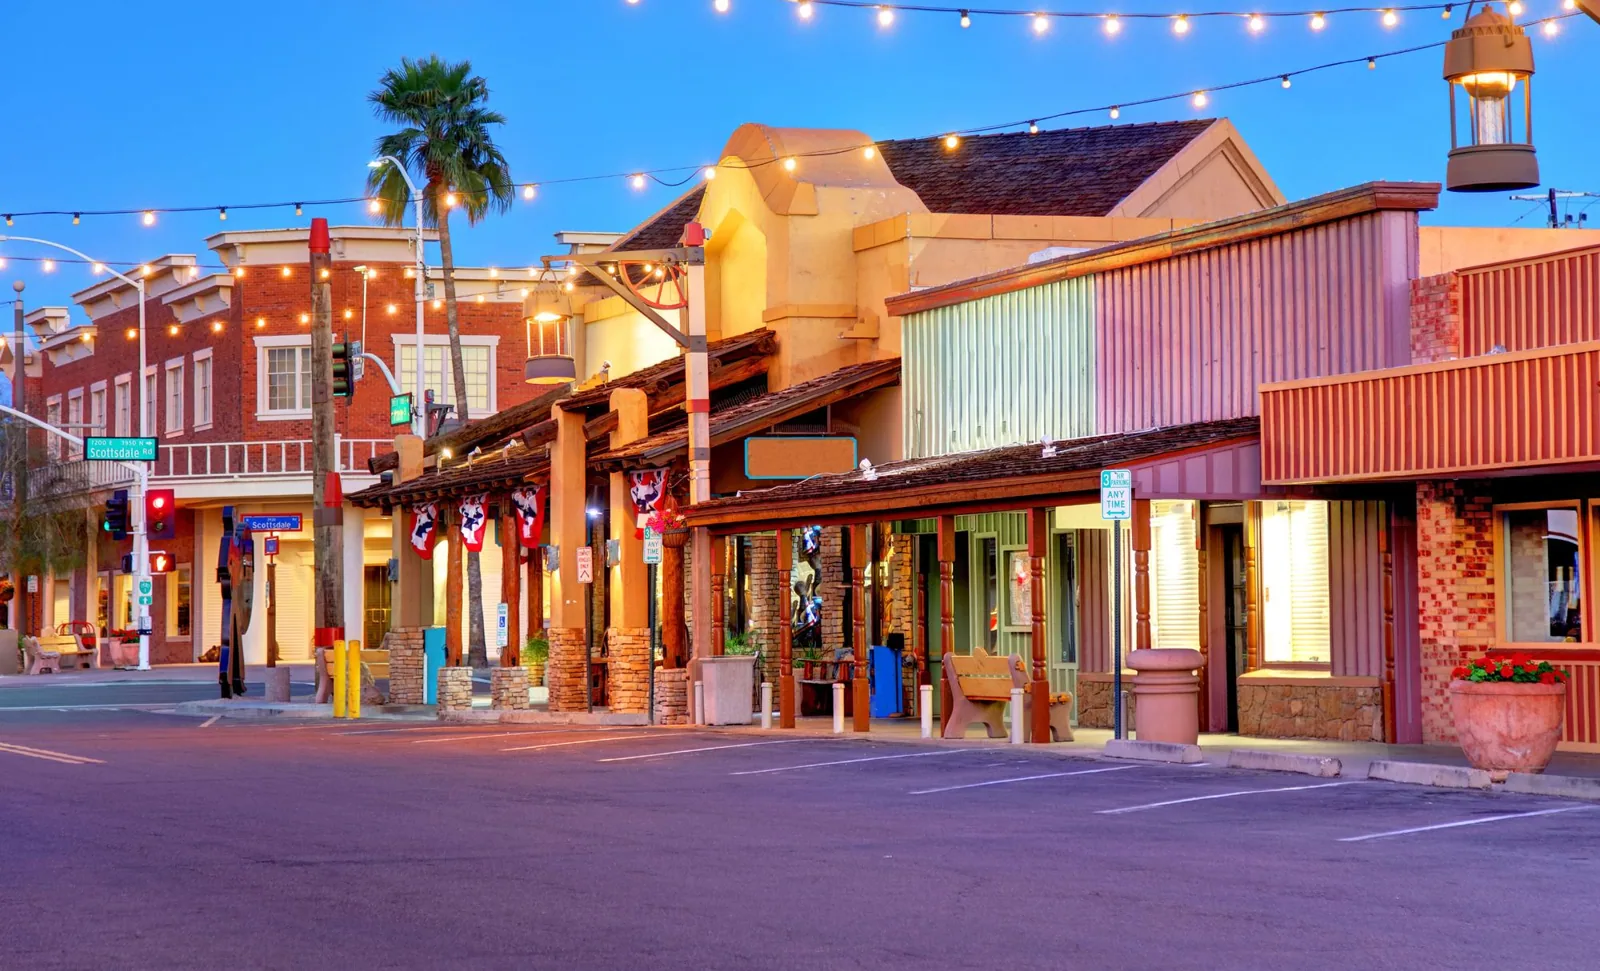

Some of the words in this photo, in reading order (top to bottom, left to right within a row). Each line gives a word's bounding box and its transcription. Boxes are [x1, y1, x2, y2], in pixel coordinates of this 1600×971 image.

[90, 448, 140, 458] Scottsdale
[1103, 474, 1110, 486] 3
[1107, 490, 1125, 498] ANY
[1107, 500, 1126, 509] TIME
[252, 521, 292, 529] Scottsdale
[645, 527, 650, 538] 3
